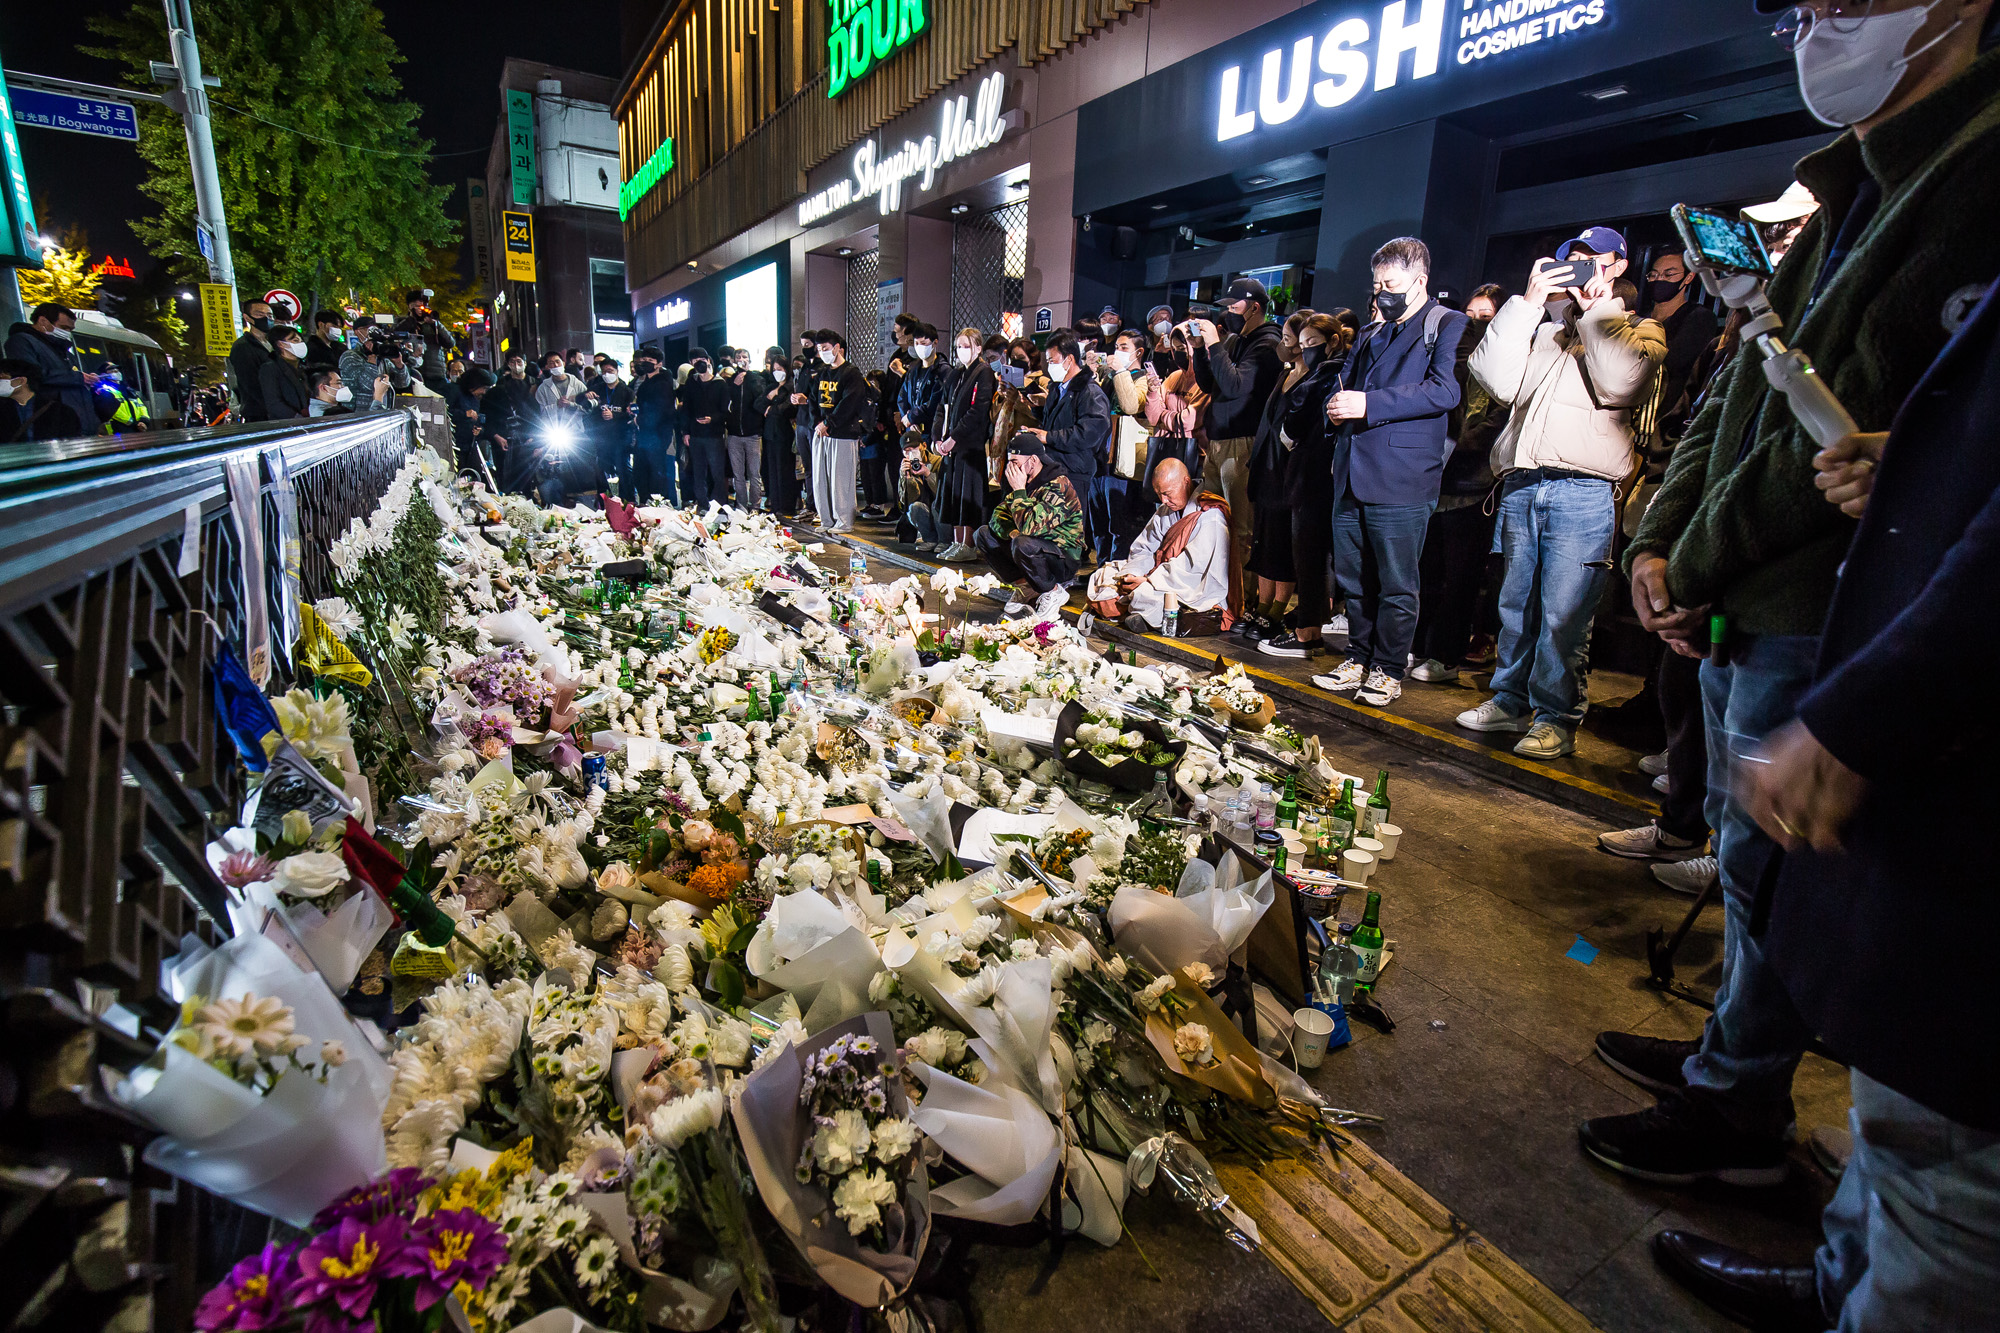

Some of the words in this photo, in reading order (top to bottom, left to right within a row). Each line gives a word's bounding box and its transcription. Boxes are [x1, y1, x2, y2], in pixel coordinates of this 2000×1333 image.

[1457, 0, 1604, 64] COSMETICS
[1460, 0, 1573, 38] HANDM
[1217, 0, 1446, 141] LUSH
[58, 115, 132, 136] Bogwang-ro
[77, 102, 131, 122] 보광로
[514, 133, 531, 172] 치과
[799, 179, 852, 226] HAMILTON
[852, 139, 937, 215] Shopping
[932, 71, 1006, 169] Mall
[509, 226, 529, 241] 24
[477, 245, 489, 284] BEACH
[1038, 319, 1048, 329] 179
